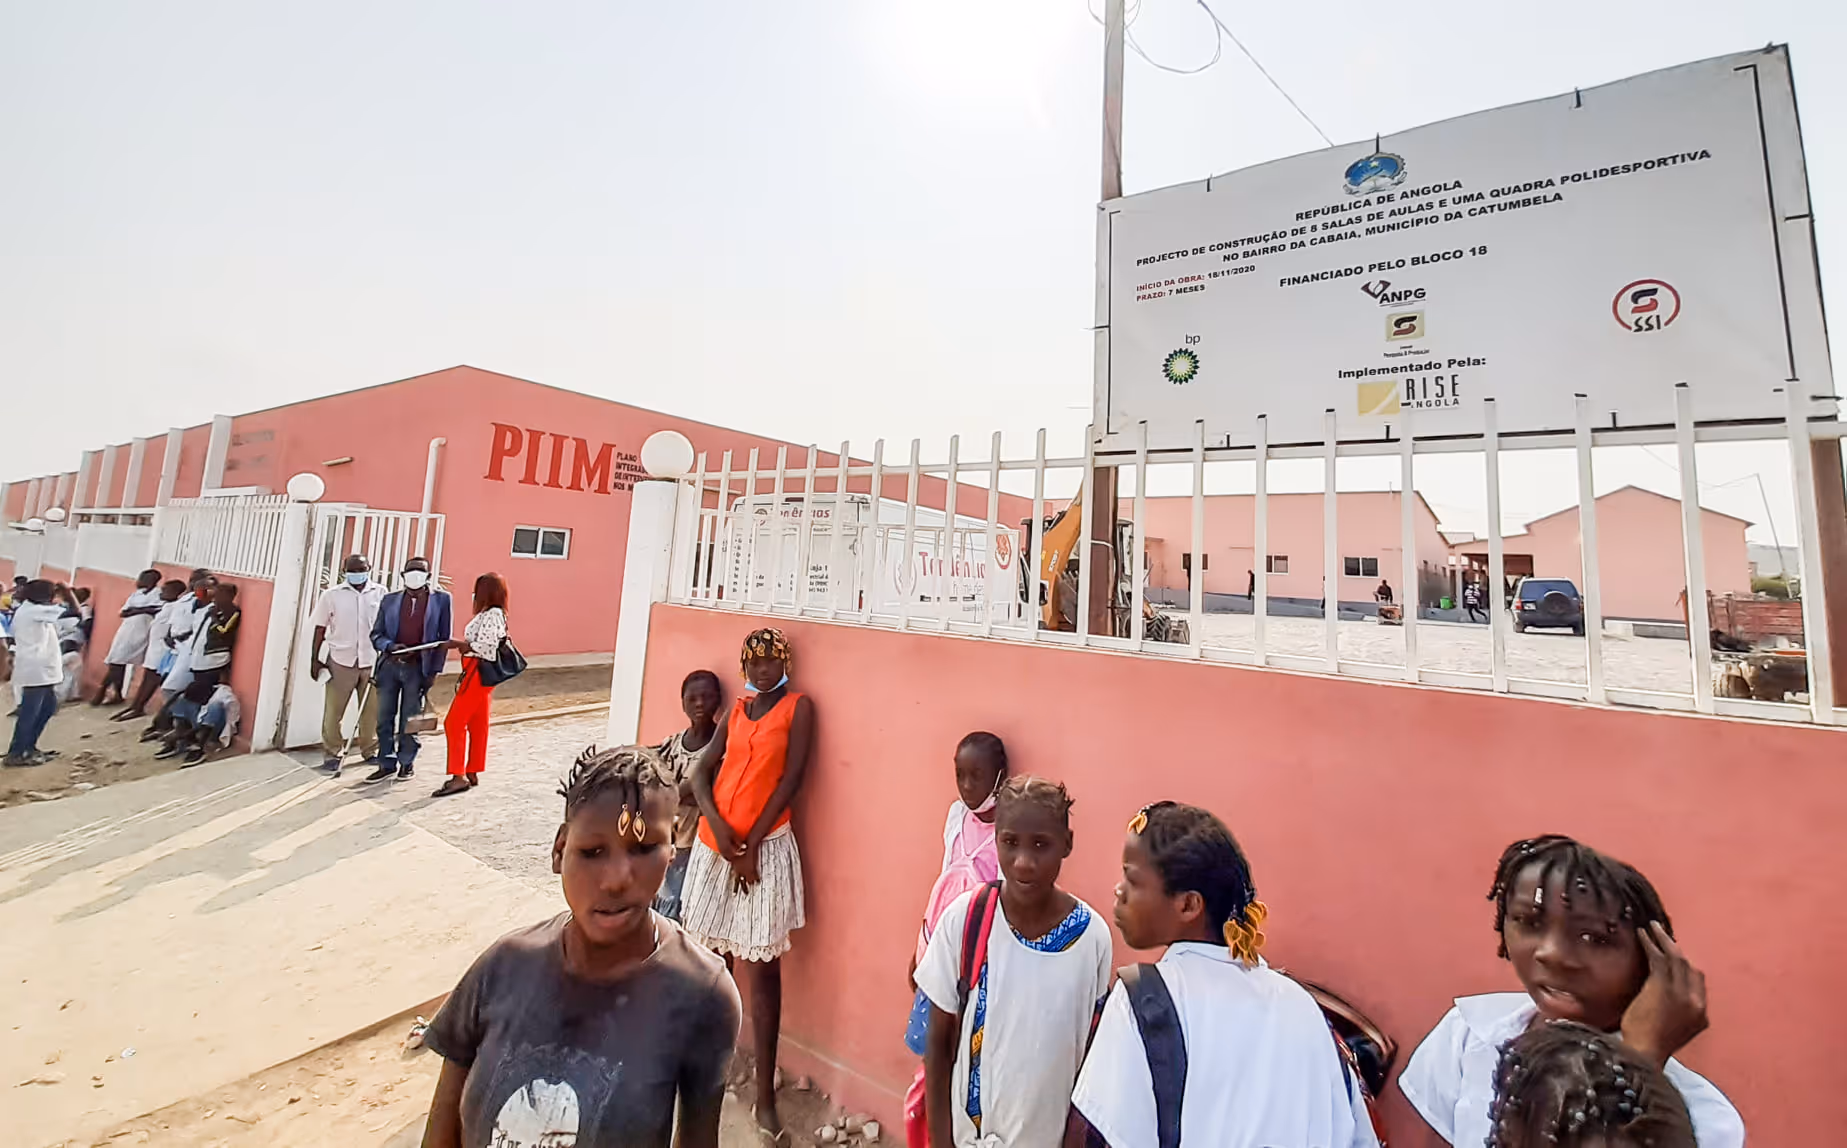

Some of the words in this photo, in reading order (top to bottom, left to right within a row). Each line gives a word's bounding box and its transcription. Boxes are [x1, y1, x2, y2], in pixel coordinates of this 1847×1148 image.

[1136, 249, 1189, 267] PROJECTO
[1191, 246, 1206, 256] DE
[1208, 230, 1288, 253] CONSTRUÇÃO
[1291, 226, 1307, 237] DE
[1310, 224, 1318, 233] 8
[1321, 215, 1363, 231] SALAS
[1366, 211, 1385, 222] DE
[1388, 201, 1434, 218] AULAS
[1438, 198, 1448, 208] E
[1452, 191, 1485, 205] UMA
[1489, 178, 1556, 198] QUADRA
[1560, 149, 1712, 185] POLIDESPORTIVA
[1295, 199, 1372, 222] REPÚBLICA
[1376, 193, 1395, 205] DE
[1399, 180, 1463, 201] ANGOLA
[1222, 252, 1239, 262] NO
[1242, 243, 1286, 259] BAIRRO
[1289, 239, 1307, 250] DA
[1309, 231, 1362, 246] CABAIA,
[1365, 214, 1439, 236] MUNICÍPIO
[1443, 210, 1463, 222] DA
[1467, 191, 1563, 217] CATUMBELA
[1136, 281, 1162, 292] INÍCIO
[1164, 279, 1176, 287] DA
[1178, 274, 1206, 284] OBRA:
[1207, 265, 1256, 279] 18/11/2020
[1279, 266, 1364, 287] FINANCIADO
[1368, 258, 1406, 273] PELO
[1410, 249, 1464, 266] BLOCO
[1468, 245, 1488, 257] 18
[1136, 291, 1166, 302] PRAZO:
[1175, 284, 1206, 295] MESES
[1379, 287, 1427, 304] ANPG
[1632, 314, 1661, 333] SSI
[1185, 333, 1201, 346] bp
[1338, 360, 1442, 380] Implementado
[1447, 357, 1487, 369] Pela:
[1405, 374, 1460, 400] RISE
[1408, 398, 1460, 409] NGOLA
[483, 422, 617, 495] PIIM
